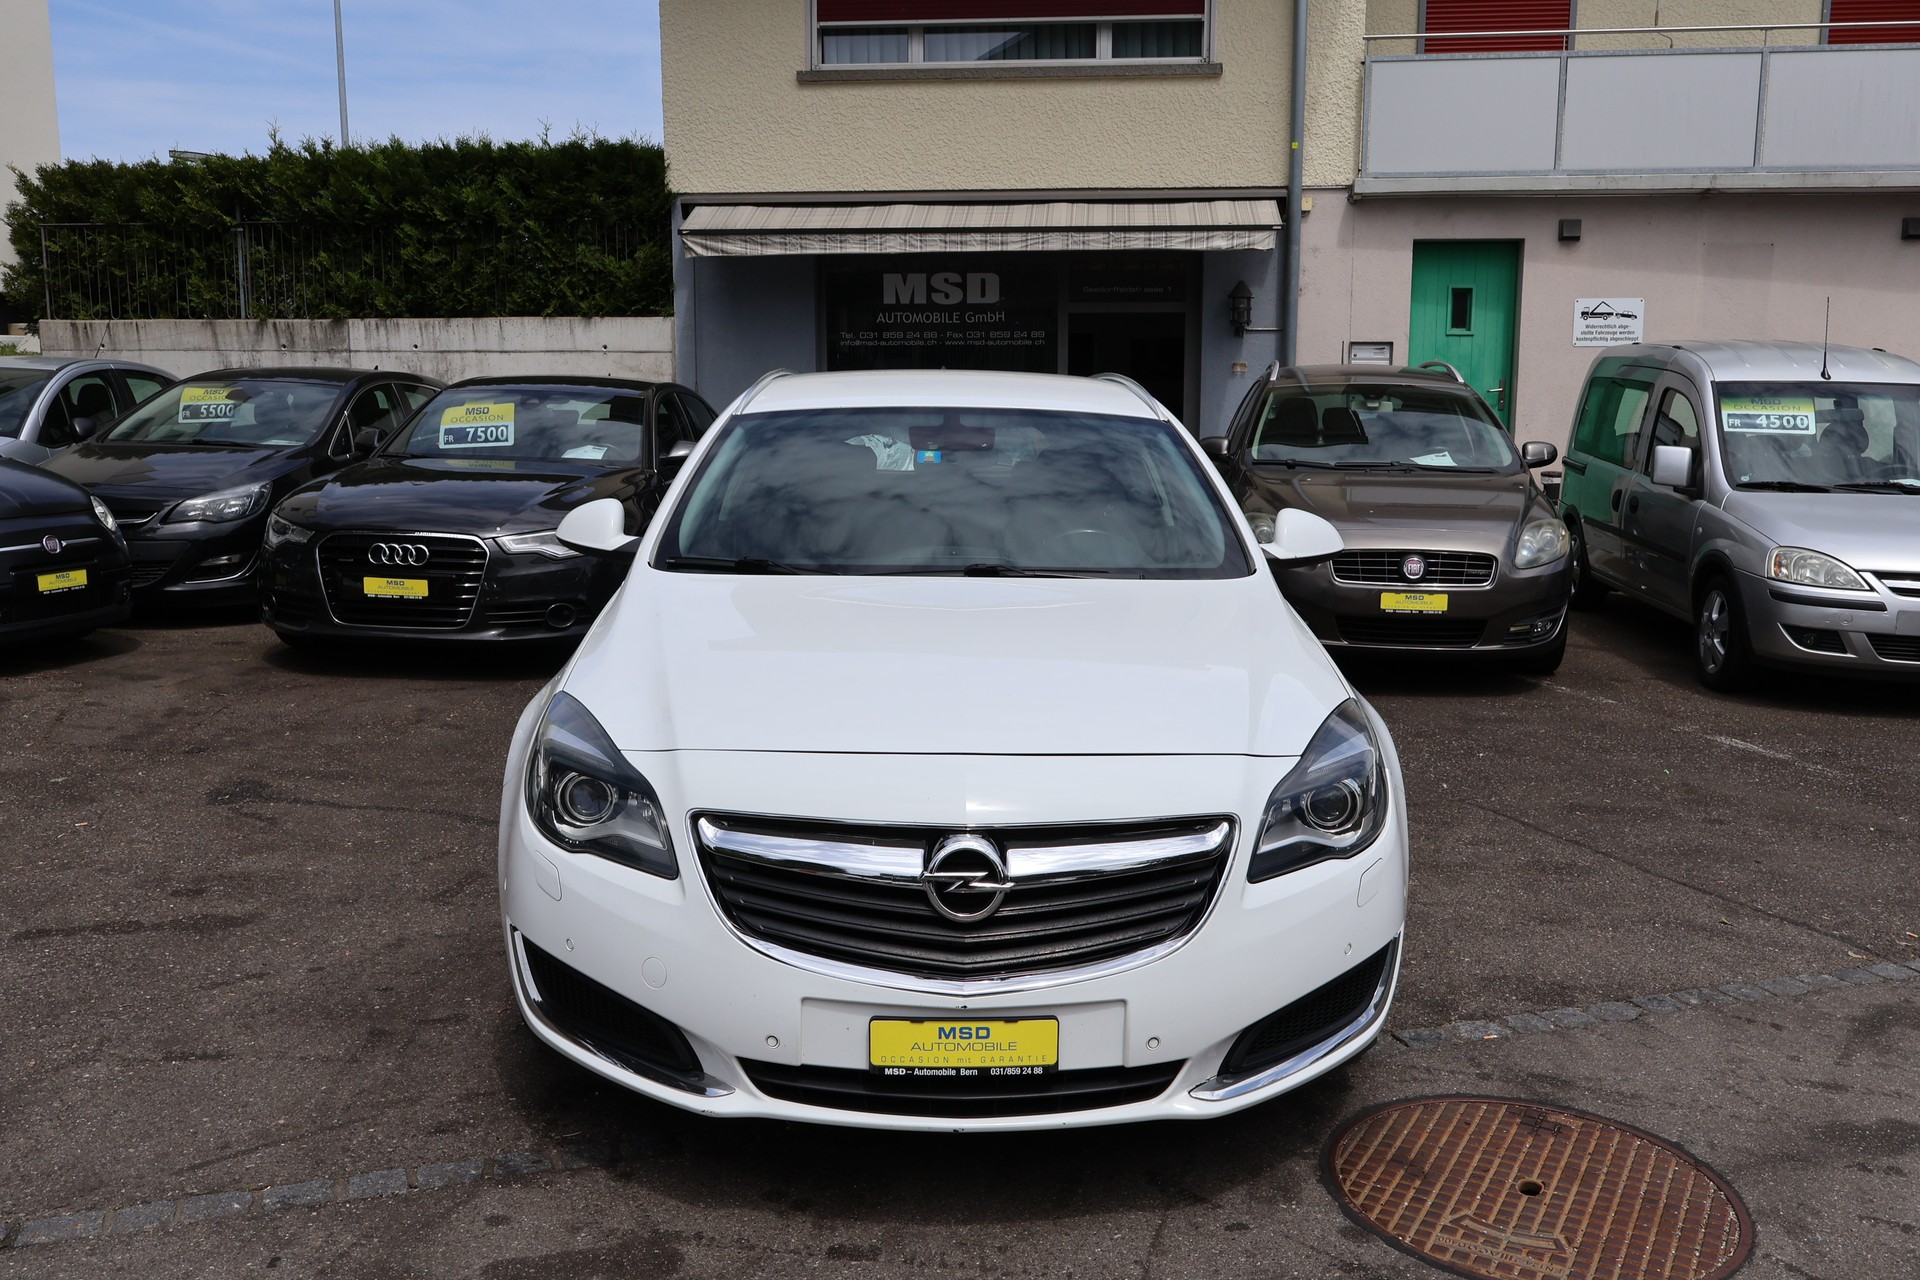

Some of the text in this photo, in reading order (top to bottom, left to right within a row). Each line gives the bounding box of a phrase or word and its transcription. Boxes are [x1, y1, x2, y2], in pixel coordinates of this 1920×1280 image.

[883, 272, 1000, 305] MSD
[876, 311, 1005, 323] AUTOMOBILE GmbH
[182, 404, 234, 418] FR 5500
[465, 407, 490, 415] MSD
[450, 414, 504, 423] OCCASION
[1728, 415, 1809, 429] FR 4500
[444, 427, 507, 443] FR 7500
[938, 1026, 990, 1040] MSD
[910, 1042, 1018, 1052] AUTOMOBILE
[881, 1055, 1047, 1064] OCCASION mit GARANTIE
[914, 1068, 956, 1076] Automobile
[960, 1068, 978, 1076] Bern
[990, 1067, 1021, 1075] 031/859
[1022, 1067, 1032, 1075] 24
